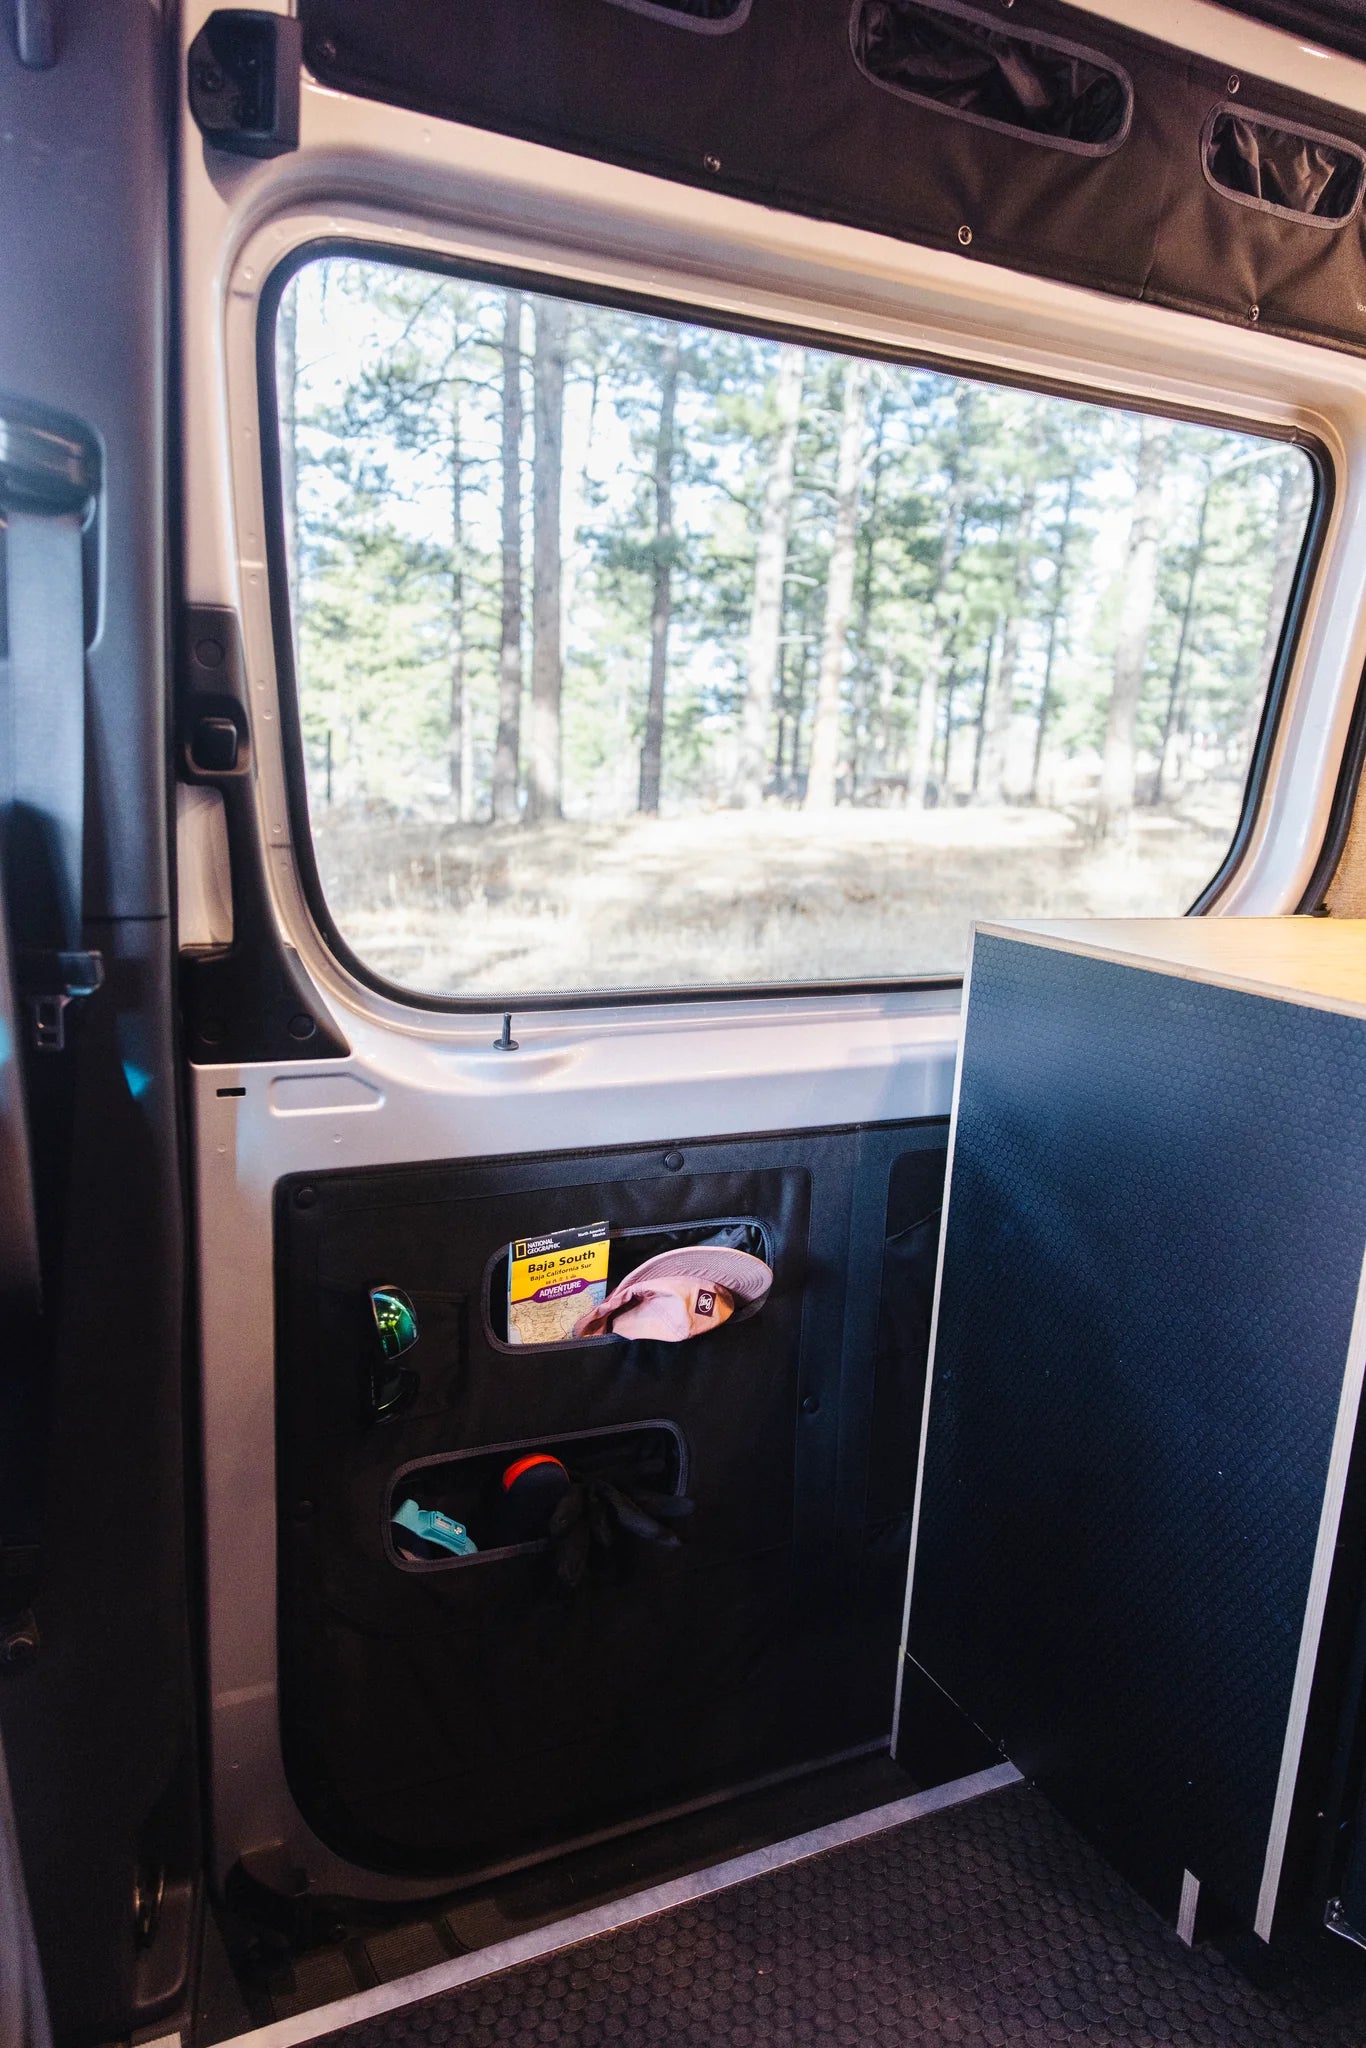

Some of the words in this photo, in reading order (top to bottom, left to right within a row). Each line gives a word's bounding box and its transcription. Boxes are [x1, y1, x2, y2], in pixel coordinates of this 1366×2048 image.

[527, 1238, 553, 1249] NATIONAL
[527, 1242, 560, 1254] GEOGRAPHIC
[528, 1261, 554, 1273] Baja
[559, 1250, 595, 1265] South
[531, 1274, 545, 1282] Baja
[547, 1266, 579, 1278] California
[539, 1281, 582, 1297] ADVENTURE
